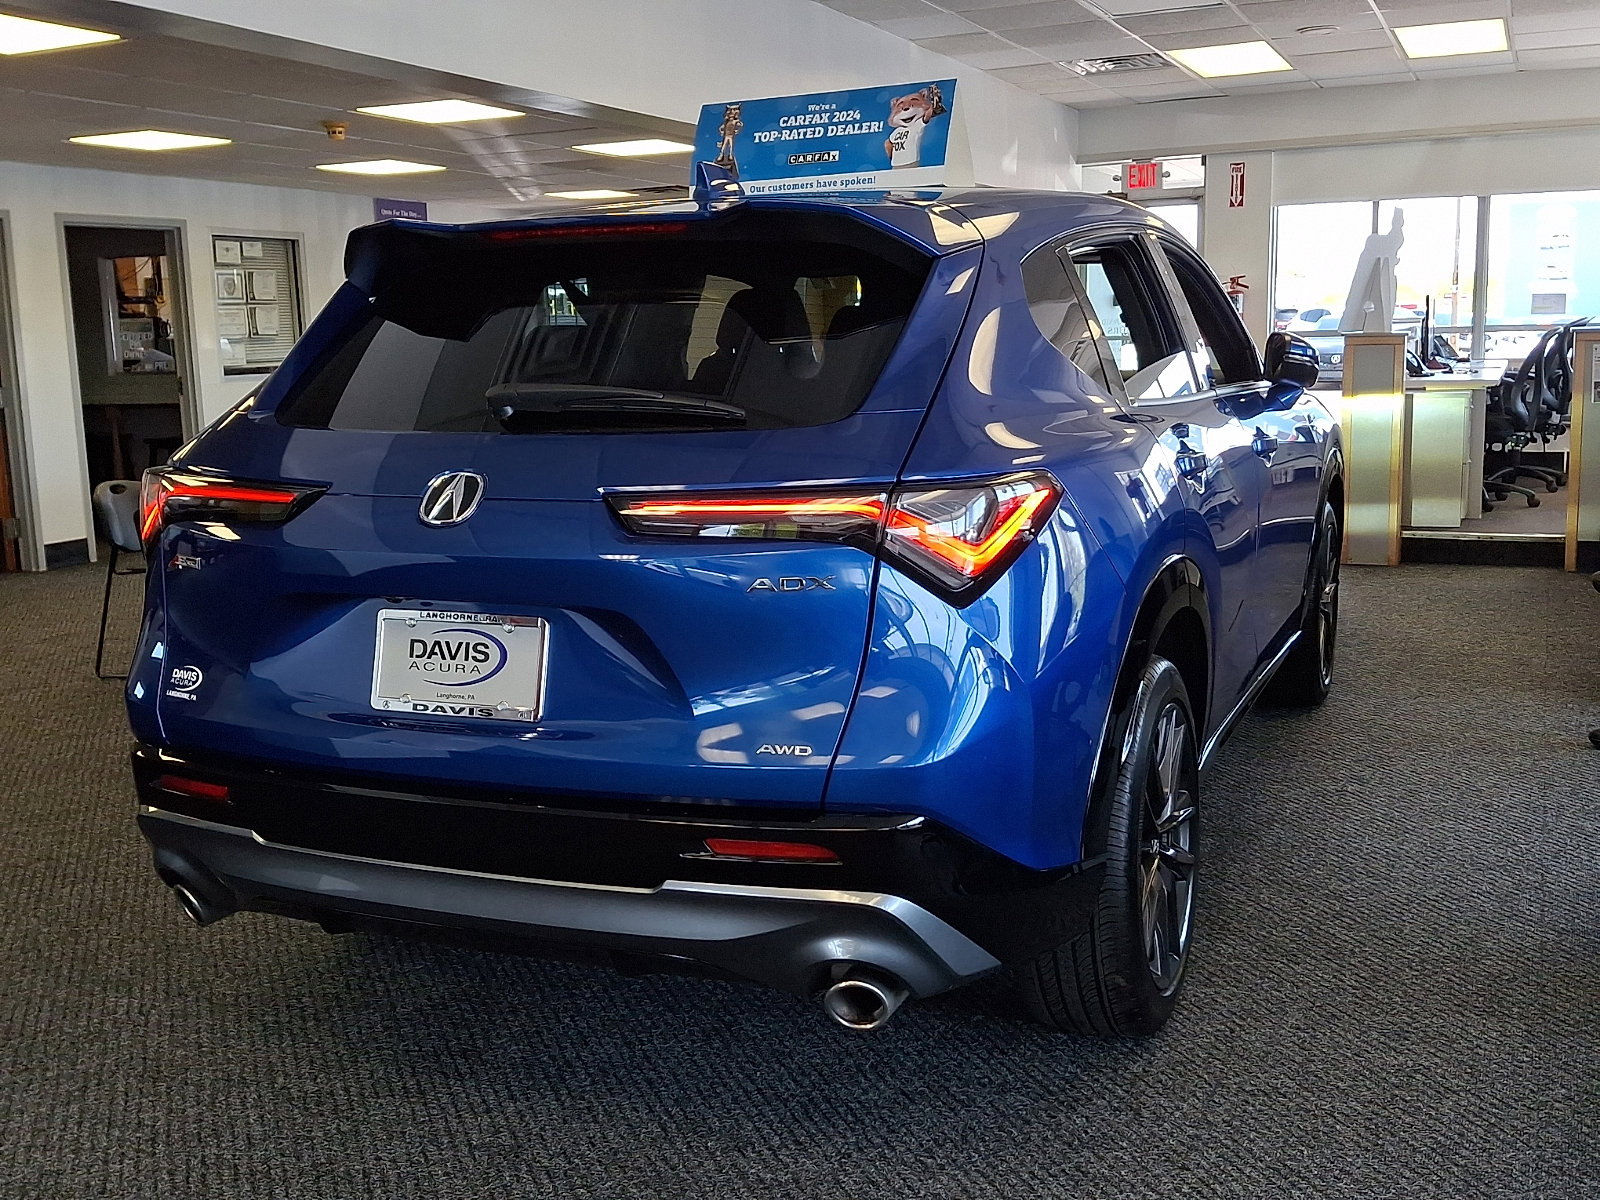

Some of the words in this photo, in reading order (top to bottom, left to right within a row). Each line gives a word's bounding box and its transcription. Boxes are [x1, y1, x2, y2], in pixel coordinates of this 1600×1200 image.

[808, 104, 829, 112] We're
[779, 113, 830, 128] CARFAX
[833, 109, 861, 123] 2024
[753, 127, 824, 143] TOP-RATED
[826, 121, 884, 137] DEALER!
[893, 130, 909, 142] CAR
[788, 151, 839, 165] CARFAX
[1128, 163, 1158, 189] EXIT
[749, 184, 765, 194] Our
[767, 180, 814, 192] customers
[816, 178, 838, 188] have
[839, 176, 876, 188] spoken!
[746, 575, 837, 593] ADX
[409, 639, 490, 663] DAVIS
[172, 669, 197, 681] DAVIS
[408, 660, 482, 675] ACURA
[170, 678, 193, 686] ACURA
[436, 691, 466, 700] Langhorne,
[411, 702, 495, 717] DAVIS
[756, 743, 813, 757] AWD
